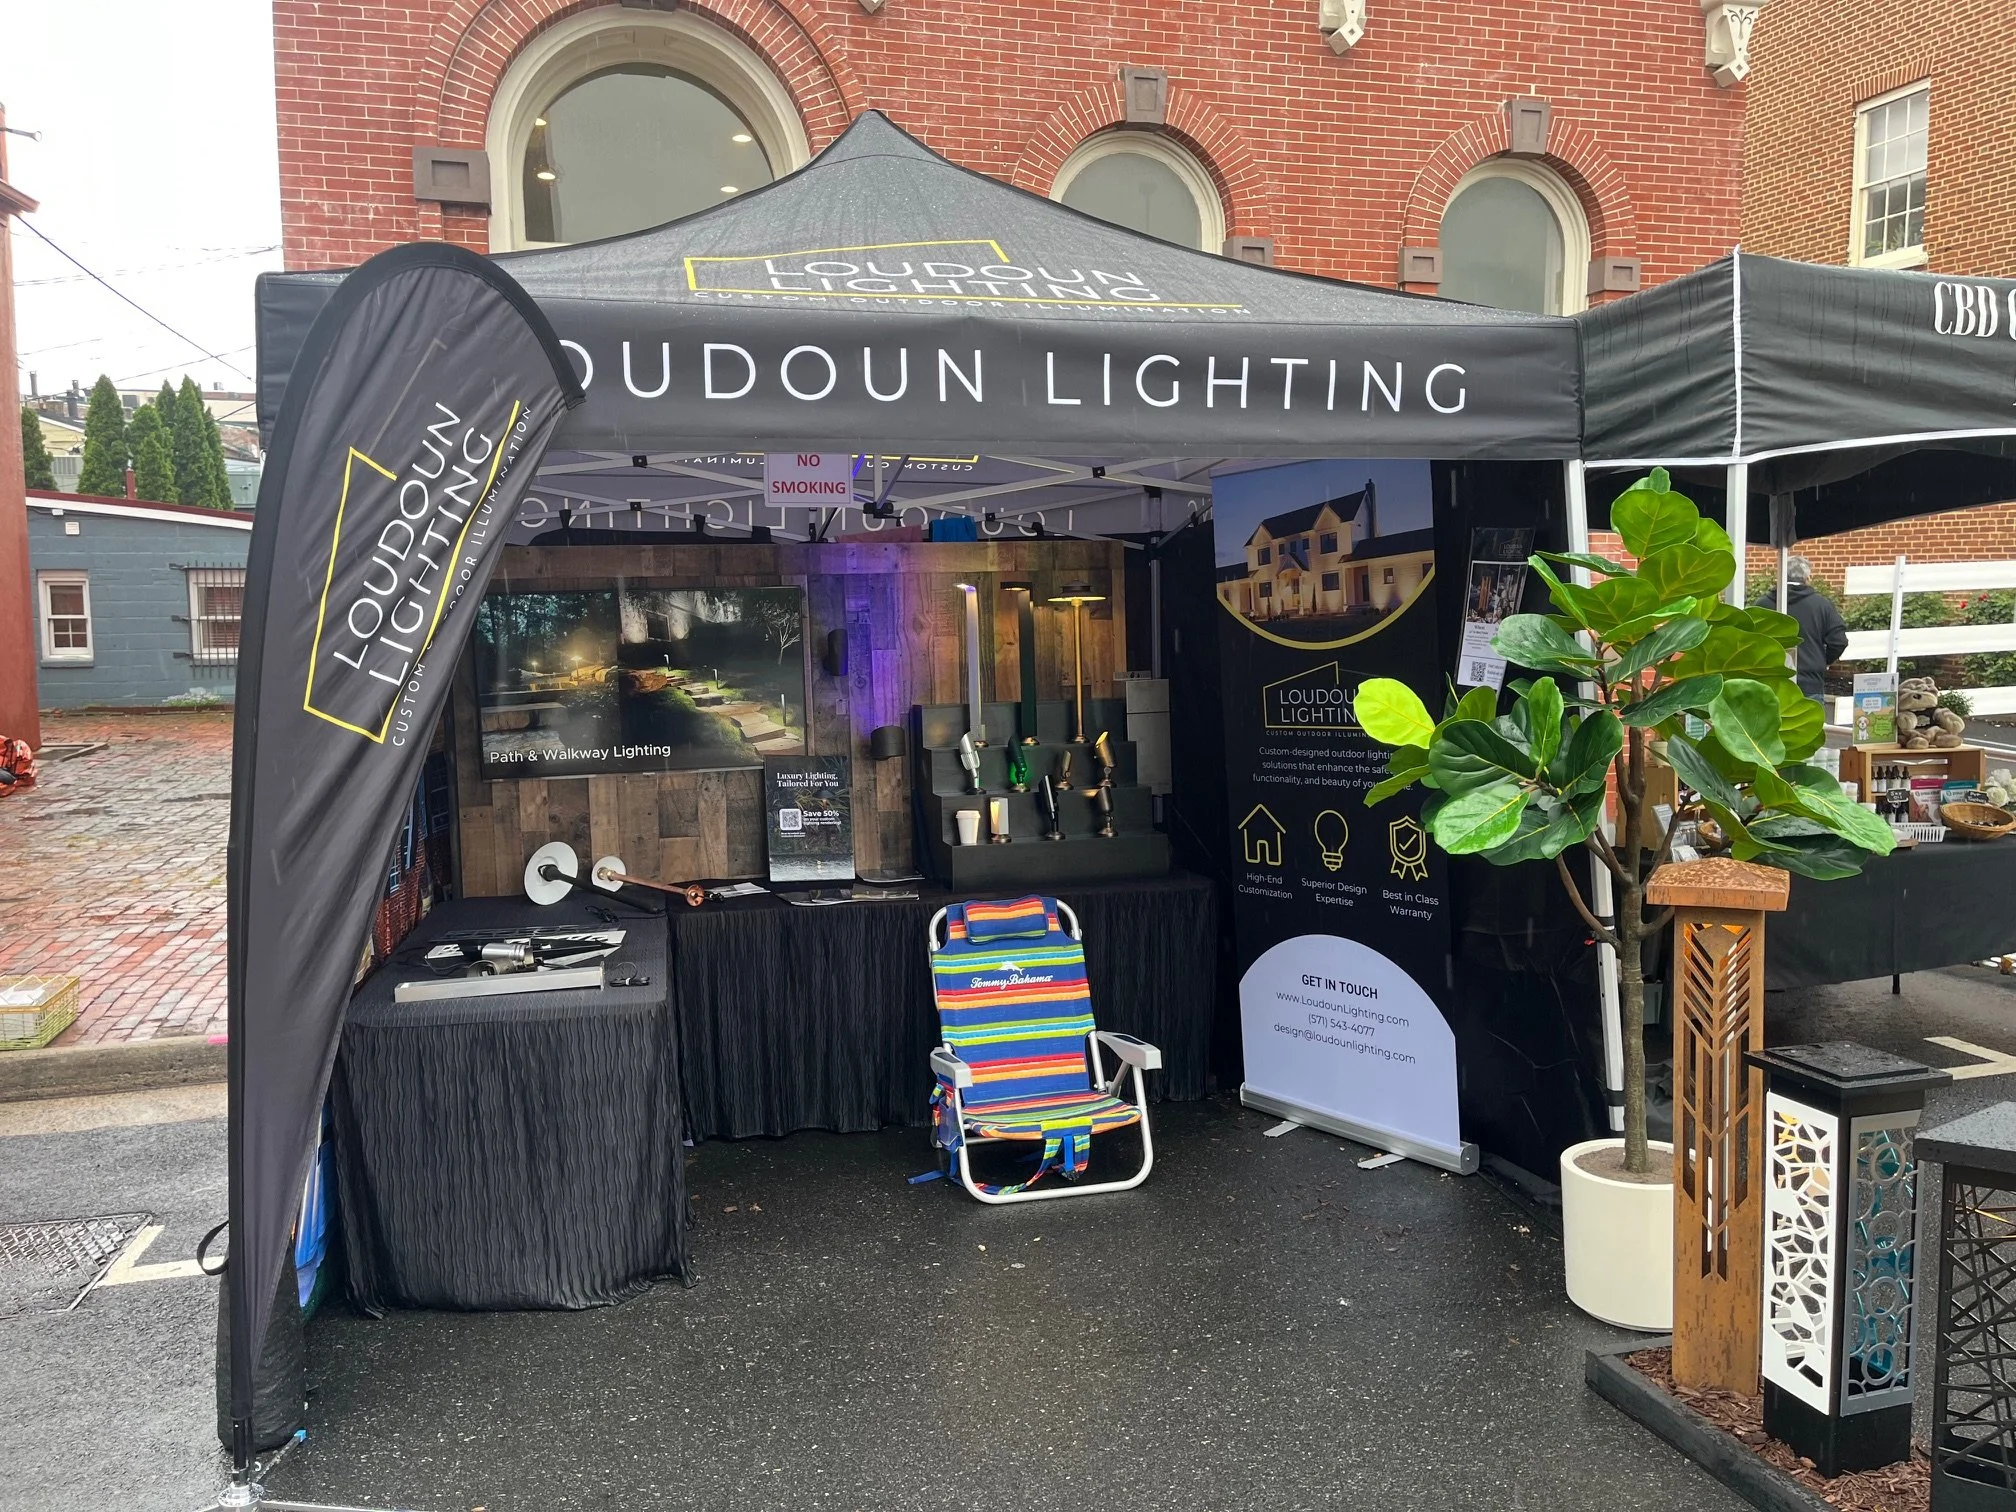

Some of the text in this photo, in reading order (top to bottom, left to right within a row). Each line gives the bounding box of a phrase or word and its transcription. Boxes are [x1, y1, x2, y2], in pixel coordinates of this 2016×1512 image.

[764, 259, 1144, 287] LOUDOUN
[770, 277, 1161, 301] LIGHTING
[694, 292, 1251, 314] CUSTOM OUTDOOR ILLUMINATION
[1934, 281, 1998, 338] CBD
[557, 338, 1467, 414] OUDOUN LIGHTING
[797, 454, 820, 467] NO
[772, 480, 846, 494] SMOKING
[333, 401, 461, 670] LOUDOUN
[368, 426, 493, 687] LIGHTING
[393, 663, 426, 746] CUSTOM
[470, 406, 532, 545] ILLUMINATION
[1280, 689, 1356, 704] LOUDOU
[1281, 708, 1356, 723] LIGHTIN
[490, 744, 671, 763] Path & Walkway Lighting
[1259, 747, 1393, 760] Custom-designed outdoor lighti
[1262, 761, 1297, 769] solutions
[1298, 762, 1315, 771] that
[1317, 763, 1353, 772] enhance
[1355, 765, 1370, 773] the
[777, 772, 803, 780] Luxury
[1252, 773, 1303, 786] functionality,
[1304, 776, 1320, 785] and
[1321, 777, 1350, 788] beauty
[1352, 779, 1361, 787] of
[1246, 872, 1283, 885] High-End
[1301, 878, 1367, 895] Superior Design
[1238, 884, 1293, 899] Customization
[1315, 893, 1354, 907] Expertise
[1382, 889, 1439, 906] Best in Class
[1389, 905, 1433, 921] Warranty
[970, 974, 1052, 990] Tommy Bahama
[1301, 973, 1378, 1000] GET IN TOUCH
[1276, 990, 1410, 1028] www.LoudounLighting.com
[1308, 1013, 1376, 1037] (571) 543-4077
[1273, 1022, 1416, 1065] design@loudounlighting.com
